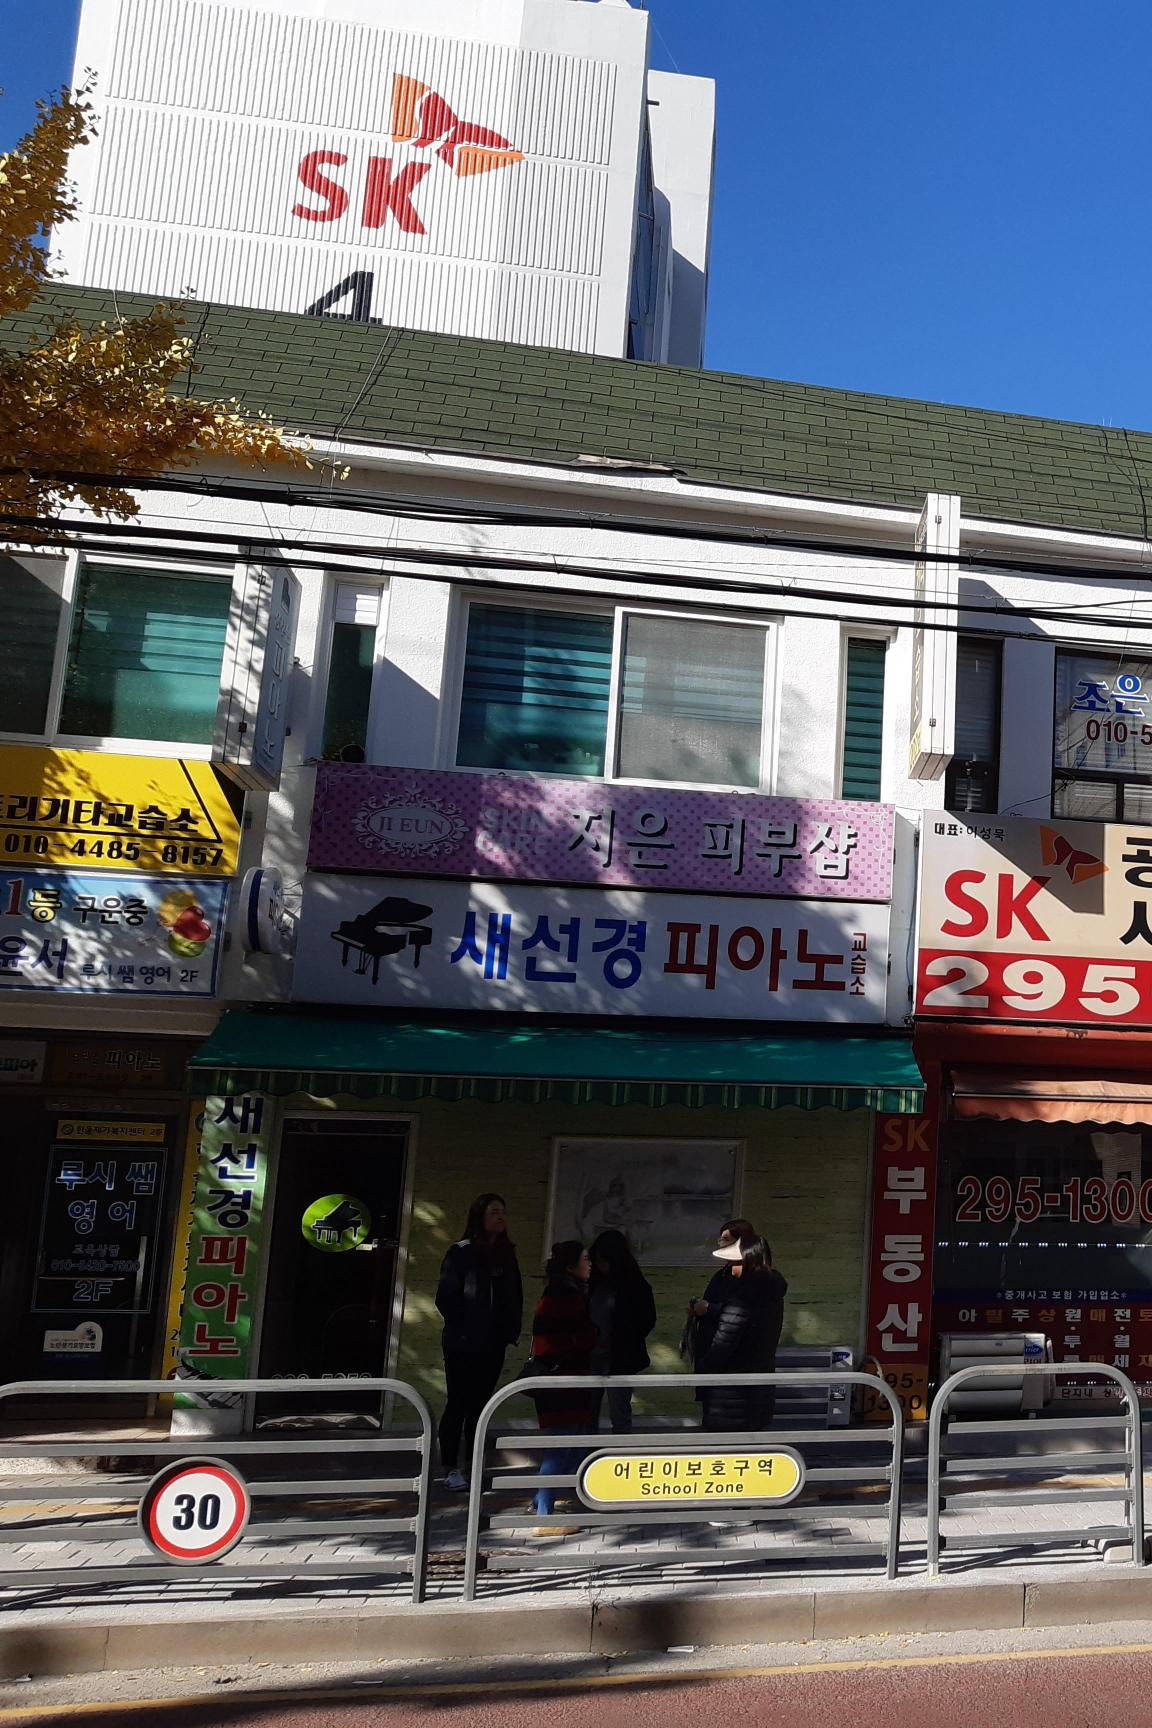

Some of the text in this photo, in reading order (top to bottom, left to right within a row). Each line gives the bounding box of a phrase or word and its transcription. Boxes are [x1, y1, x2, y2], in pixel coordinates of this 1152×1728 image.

[291, 149, 431, 235] SK
[0, 795, 199, 833] 리기타교습소
[400, 817, 445, 835] EUN
[5, 834, 224, 867] 010-4485-8157
[567, 806, 859, 881] 지은 피부샵
[73, 895, 148, 927] 구운중
[940, 869, 1052, 942] SK
[450, 911, 868, 997] 새선경 피아노 교습소
[139, 966, 171, 985] 영어
[180, 969, 199, 983] 2F
[881, 1118, 931, 1153] SK
[56, 1160, 157, 1196] 루시 쌤
[67, 1200, 137, 1235] 영어
[876, 1166, 928, 1352] 부동산
[72, 1280, 114, 1302] 2F
[1004, 1290, 1121, 1301] 중개사고 보험 가입업소
[612, 1458, 775, 1480] 어린이보호구역
[640, 1480, 745, 1496] School Zone
[172, 1493, 221, 1531] 30
